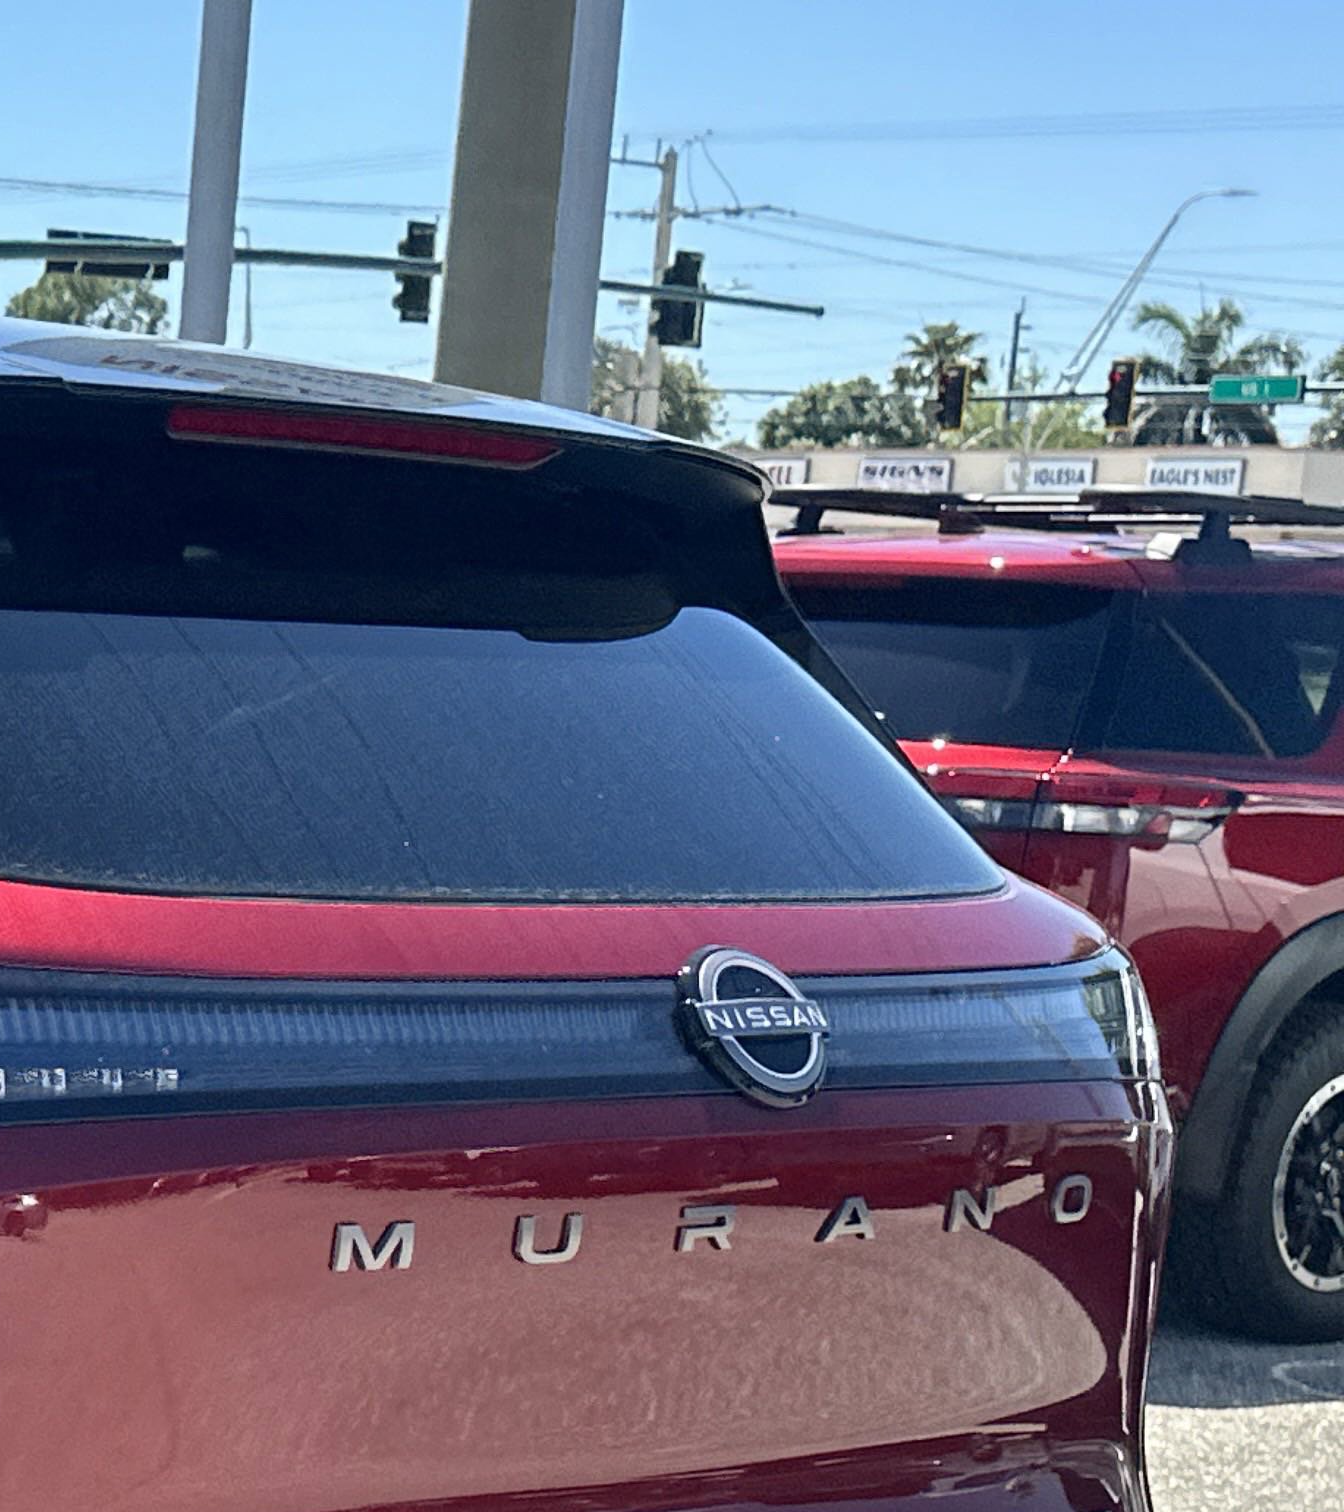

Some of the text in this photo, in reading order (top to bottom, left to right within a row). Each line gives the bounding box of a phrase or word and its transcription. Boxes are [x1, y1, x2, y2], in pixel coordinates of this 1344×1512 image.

[1034, 467, 1085, 485] IGLESIA
[1150, 468, 1236, 485] EAGLE'S NEST
[703, 1003, 828, 1032] NISSAN
[330, 1173, 1094, 1273] MURANO
